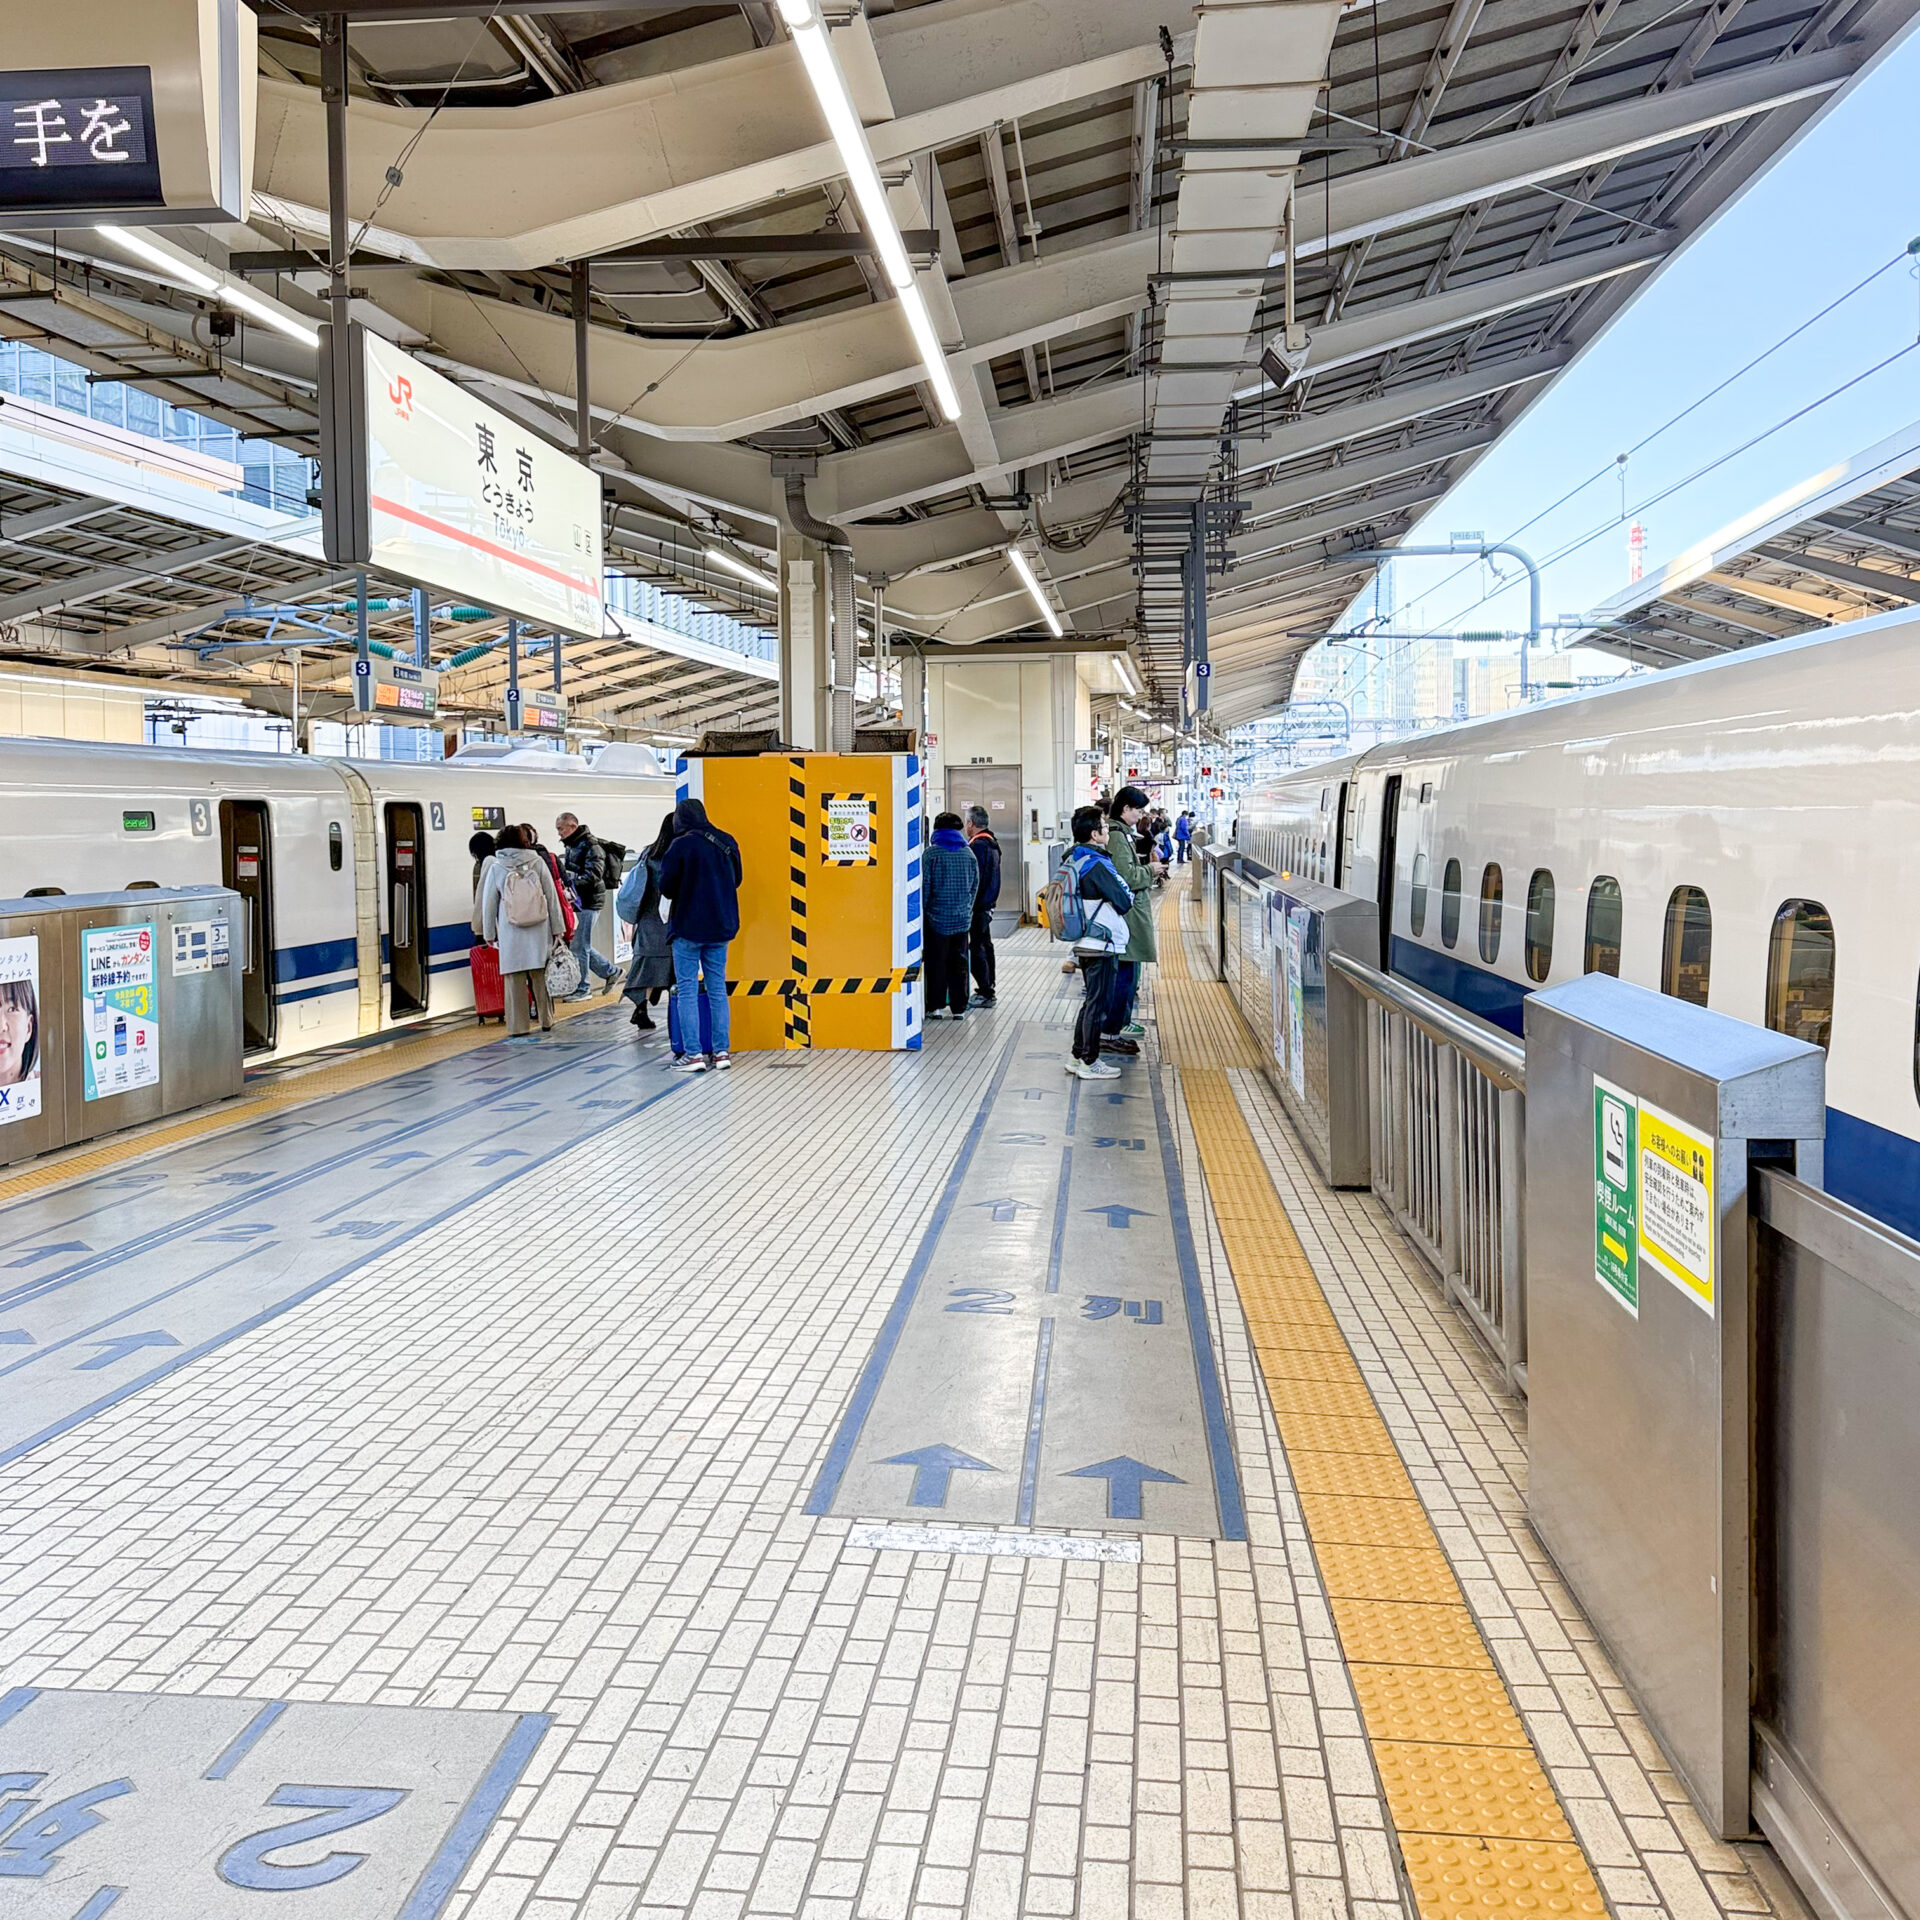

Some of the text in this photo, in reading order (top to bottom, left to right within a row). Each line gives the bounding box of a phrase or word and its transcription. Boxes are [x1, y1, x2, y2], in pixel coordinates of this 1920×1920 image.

[13, 99, 131, 166] 手を
[389, 375, 413, 411] JR
[474, 422, 535, 492] 東京
[482, 476, 534, 523] とうきょう
[493, 512, 525, 550] Tōkyō
[358, 663, 368, 675] 3
[1199, 665, 1208, 676] 3
[509, 690, 517, 701] 2
[1455, 703, 1466, 713] 15
[971, 756, 993, 765] 業務用
[194, 803, 207, 832] 3
[433, 805, 443, 828] 2
[136, 986, 148, 1016] 3
[1000, 1133, 1145, 1151] 2 列
[1651, 1133, 1691, 1166] お客様へのお願い
[1597, 1180, 1635, 1229] 喫煙ルーム
[1645, 1189, 1696, 1237] できない場合があります。
[192, 1220, 404, 1243] 2 列
[944, 1288, 1163, 1325] 2 列
[215, 1783, 414, 1892] 2
